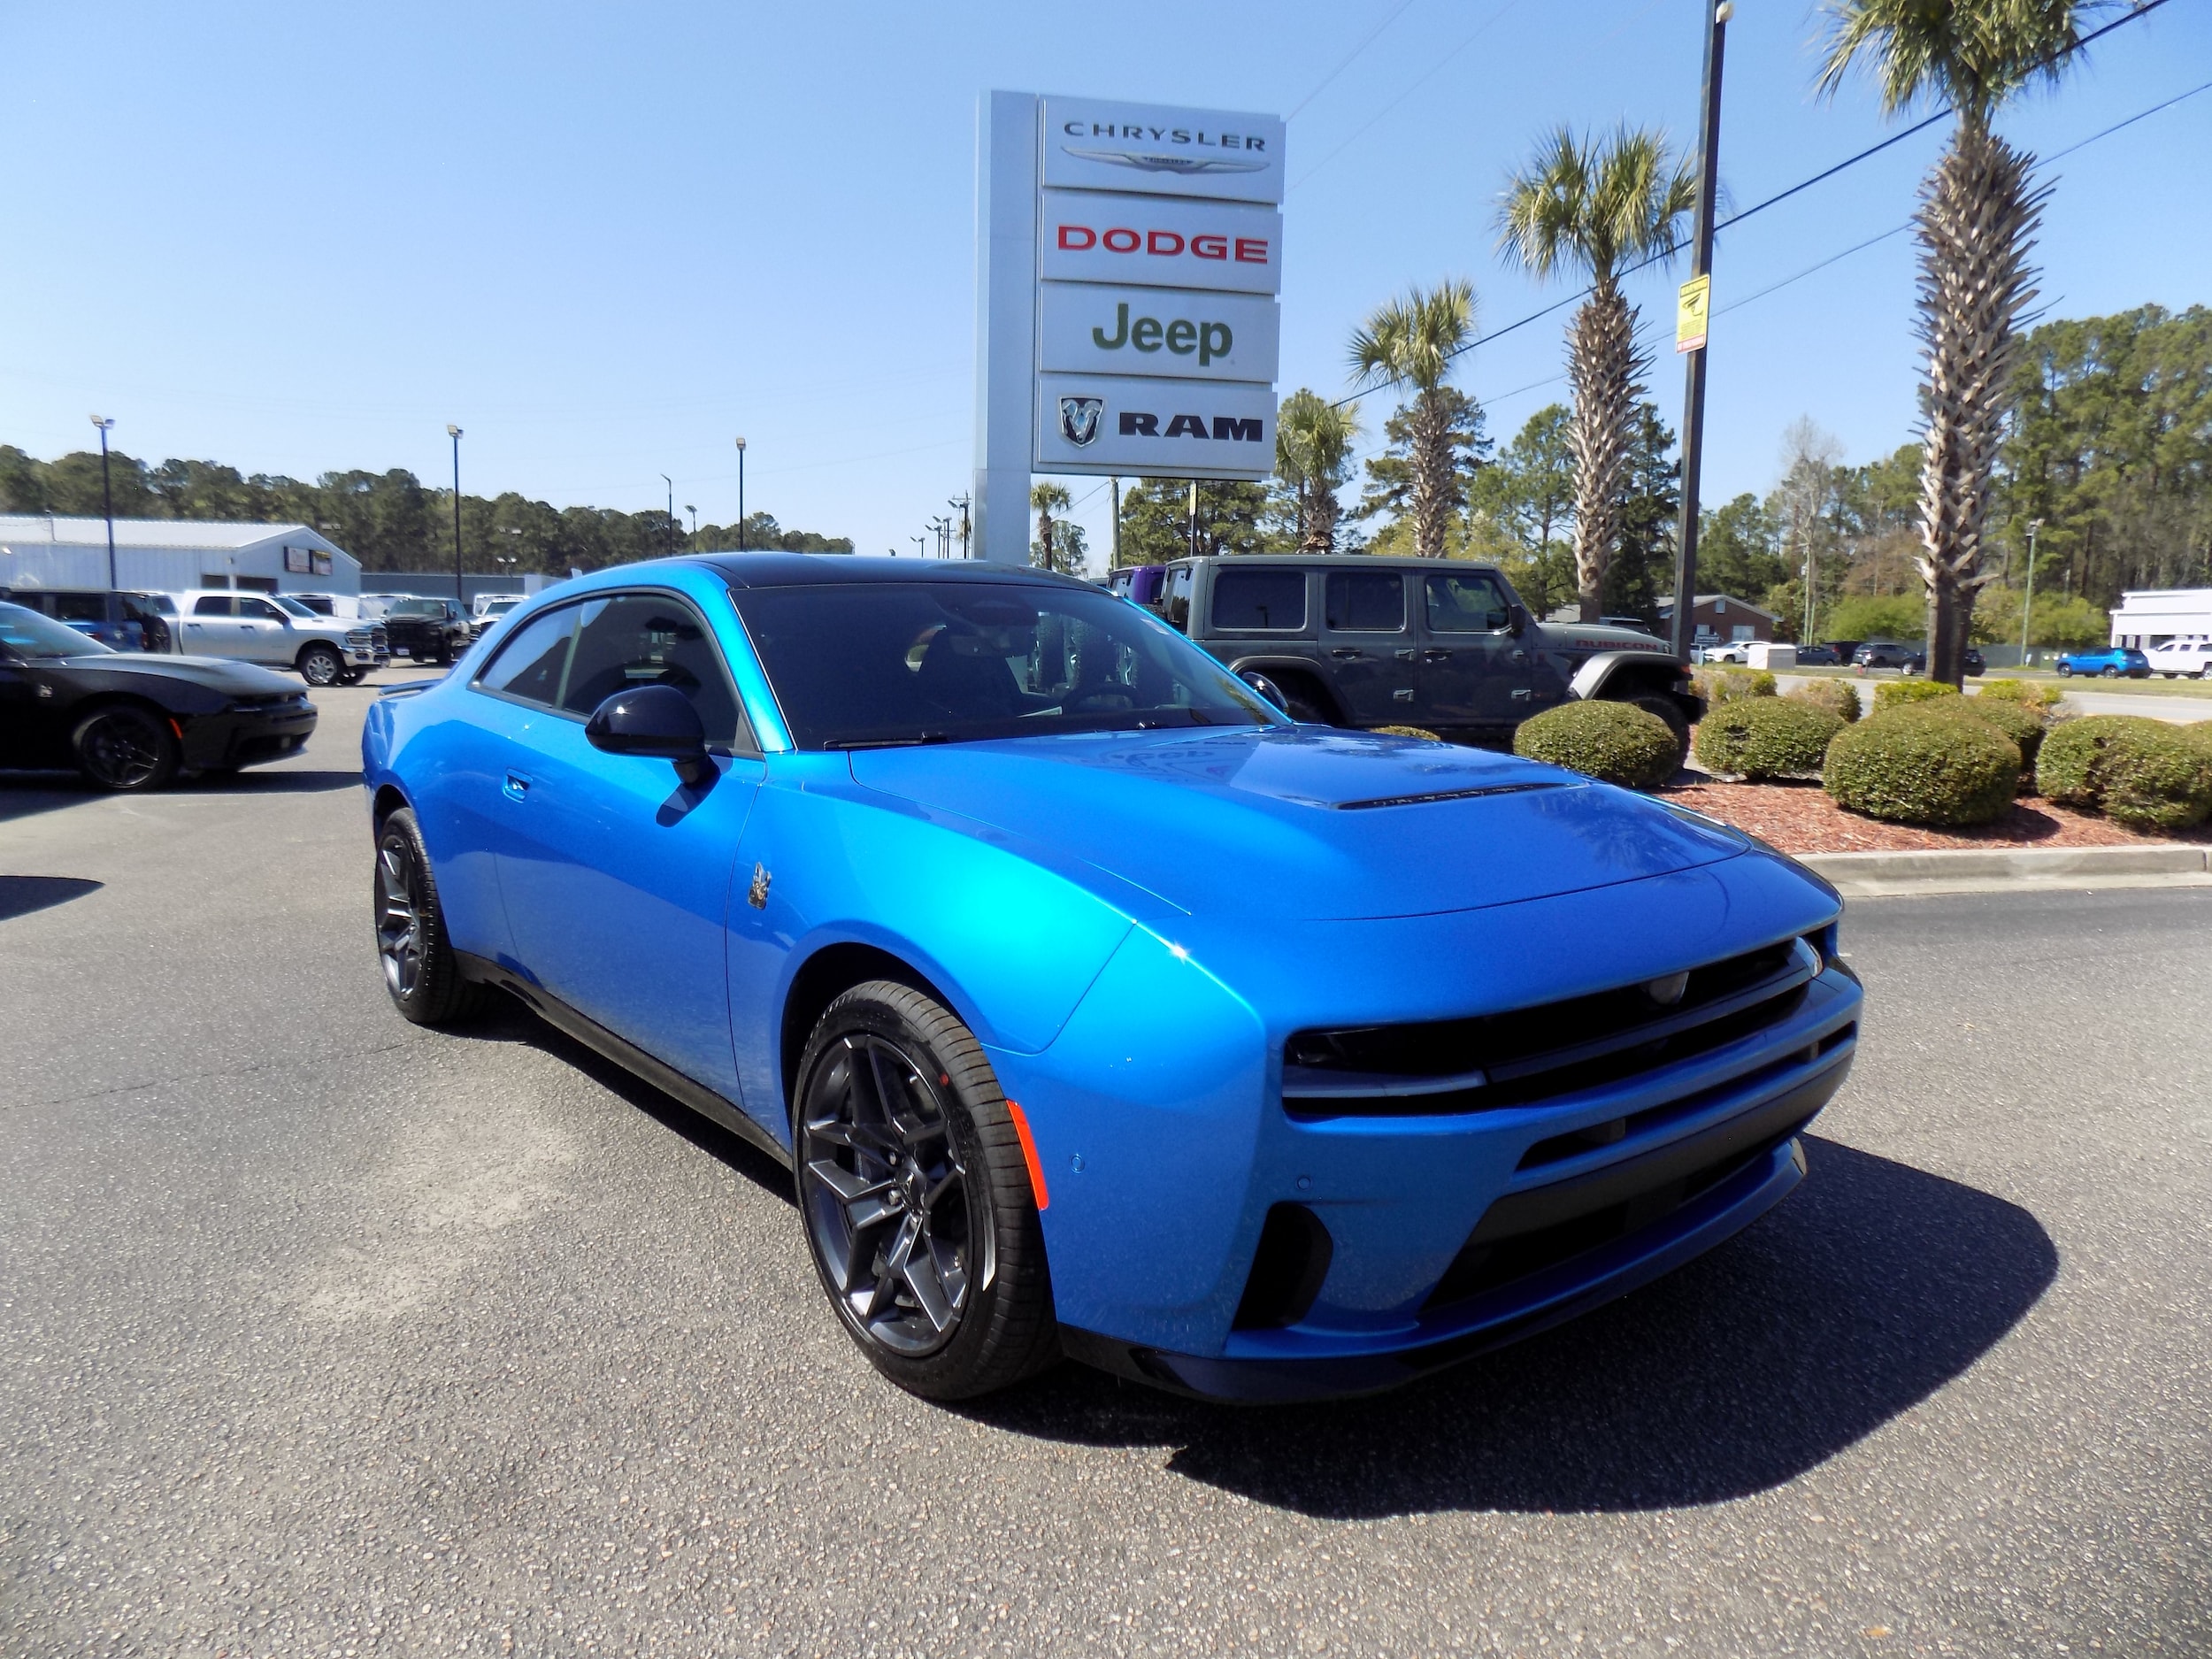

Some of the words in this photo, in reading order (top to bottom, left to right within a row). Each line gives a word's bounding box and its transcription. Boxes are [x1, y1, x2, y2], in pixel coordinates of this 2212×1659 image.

[1064, 122, 1266, 151] CHRYSLER
[1057, 226, 1269, 264] DODGE
[1092, 303, 1233, 366] Jeep
[1119, 412, 1263, 442] RAM
[1576, 640, 1657, 650] RUBICON
